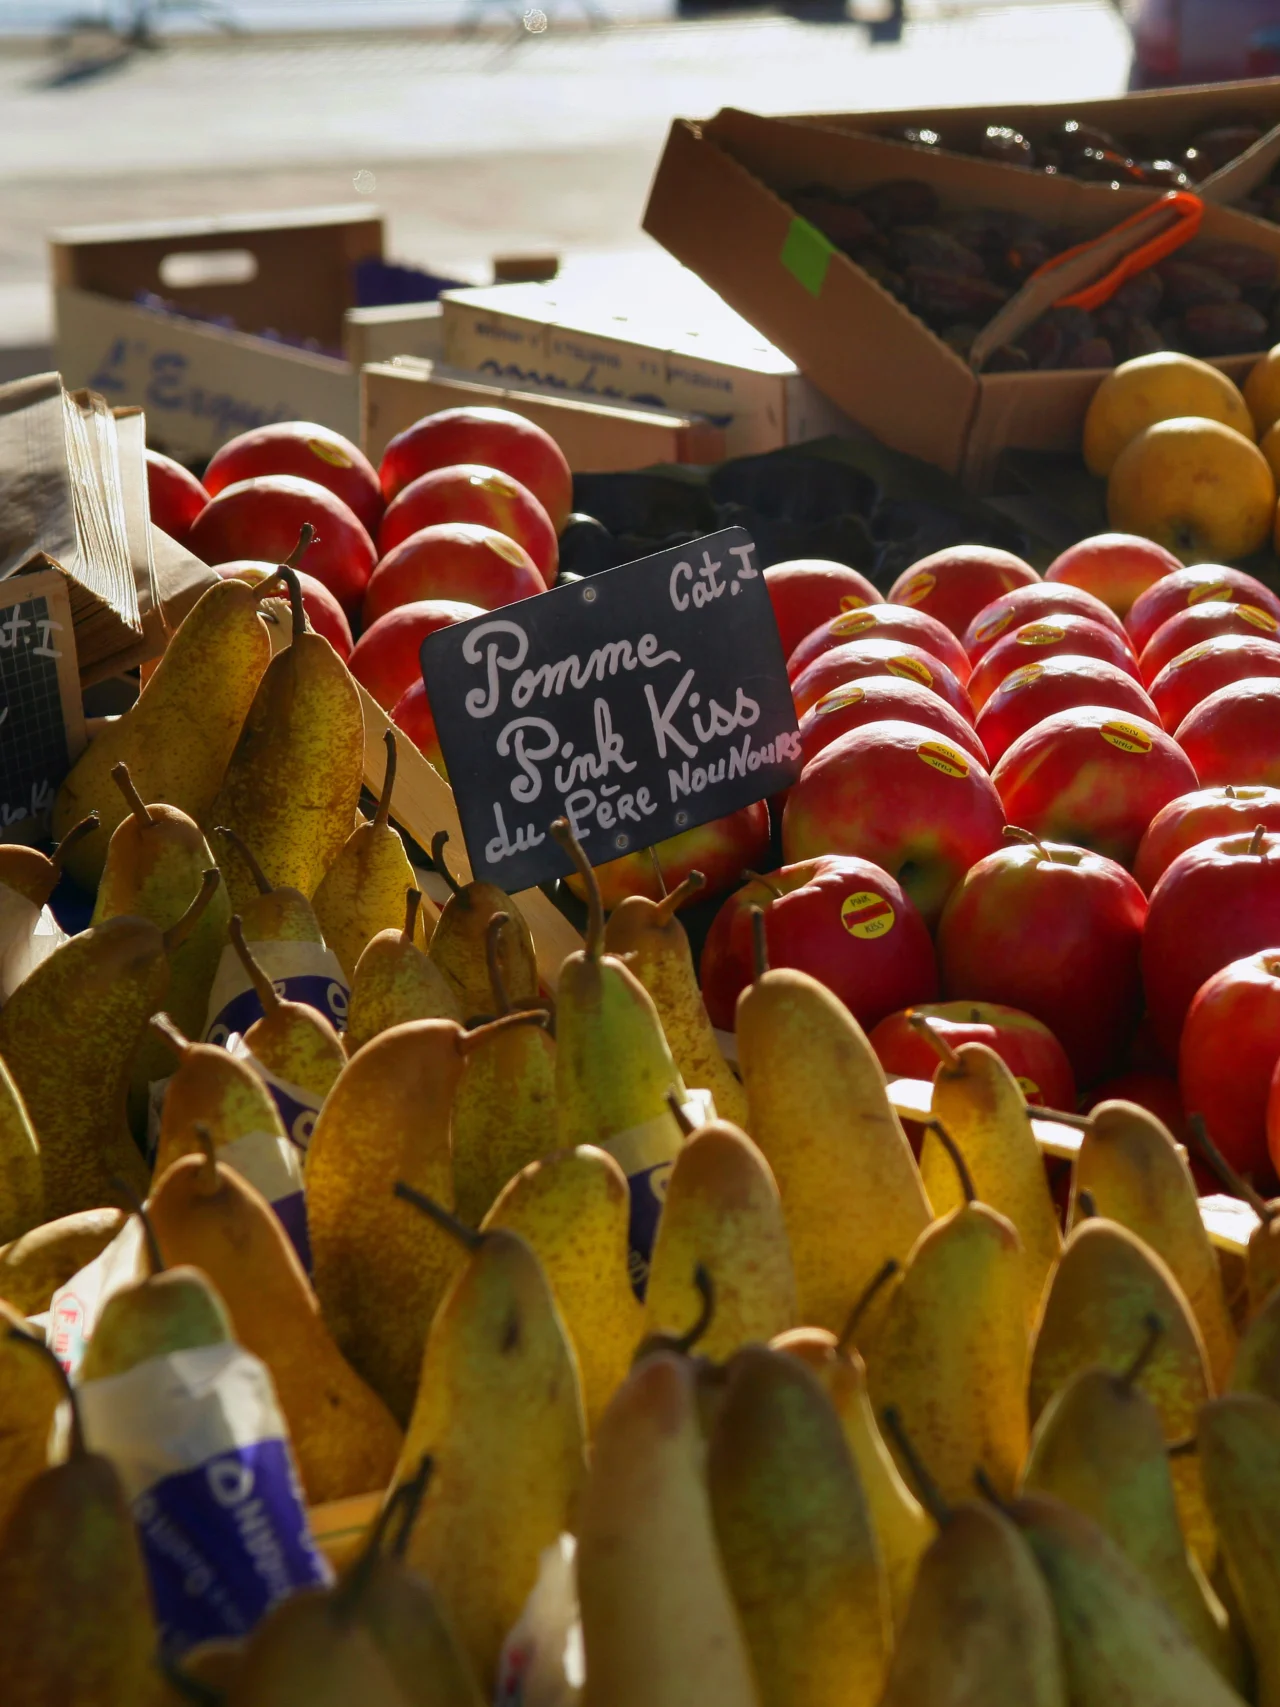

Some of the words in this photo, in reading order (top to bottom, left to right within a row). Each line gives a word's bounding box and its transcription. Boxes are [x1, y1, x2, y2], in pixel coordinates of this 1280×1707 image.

[462, 619, 682, 719] Pomme
[496, 697, 638, 803] Pink
[644, 669, 761, 759] Kiss
[485, 801, 546, 864] du
[850, 894, 871, 908] PINK
[863, 921, 885, 933] KISS
